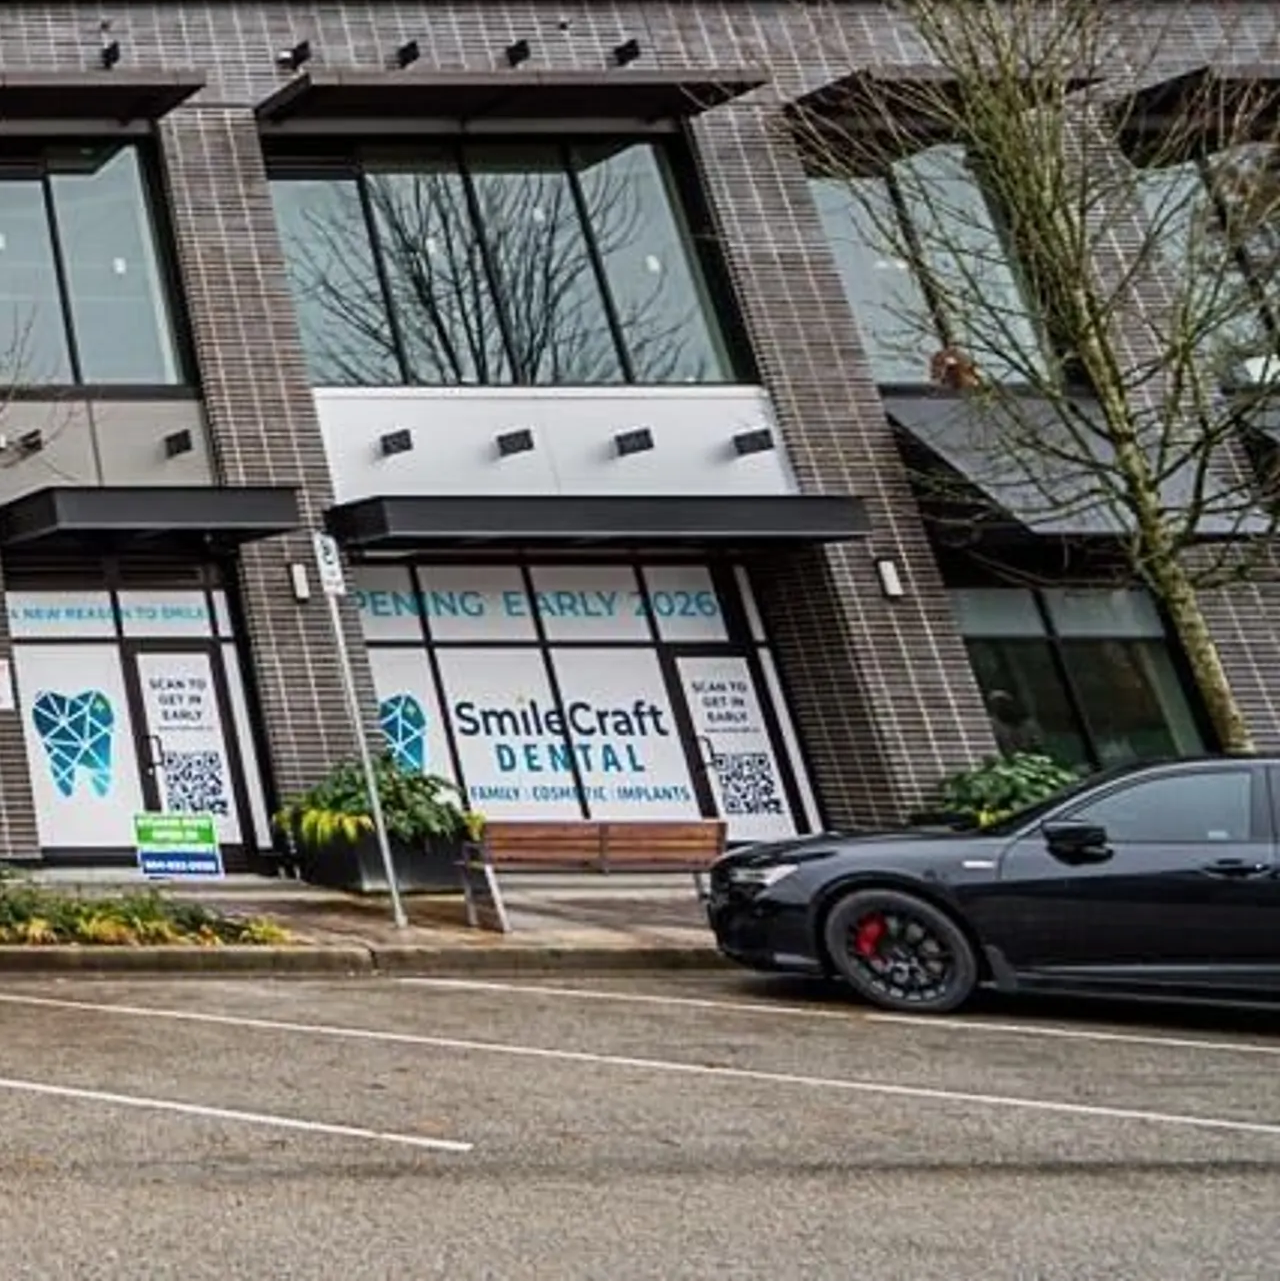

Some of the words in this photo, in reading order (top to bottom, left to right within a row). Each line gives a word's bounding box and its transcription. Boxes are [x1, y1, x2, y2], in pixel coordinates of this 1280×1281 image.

[353, 590, 484, 616] PENNG
[502, 590, 618, 616] EARLY
[629, 590, 717, 616] 2026
[455, 699, 669, 737] SmileCraft
[495, 743, 646, 772] DENTAL
[532, 786, 607, 800] COSMTIC
